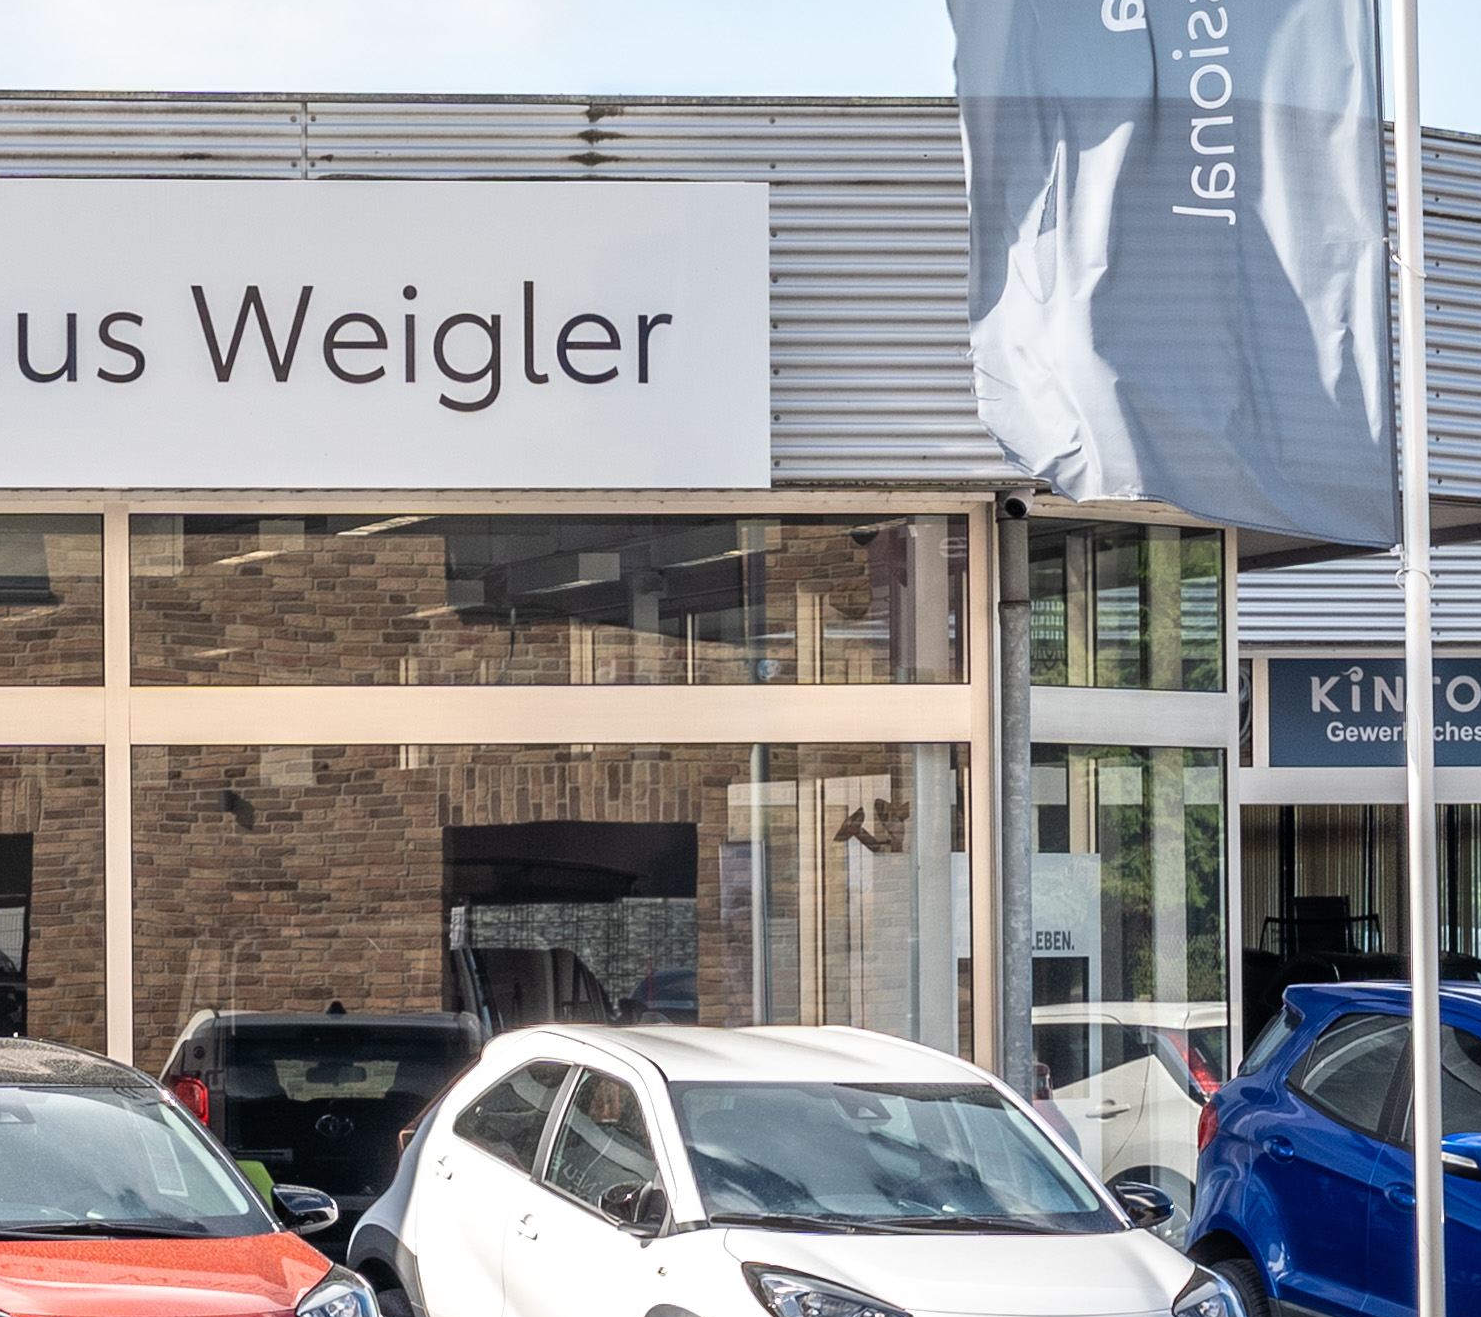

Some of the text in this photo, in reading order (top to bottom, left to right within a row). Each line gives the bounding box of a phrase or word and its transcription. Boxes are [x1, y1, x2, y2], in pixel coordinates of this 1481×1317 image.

[190, 280, 673, 414] Weigler
[1310, 666, 1481, 712] KiNO
[1031, 931, 1075, 951] EBEN.
